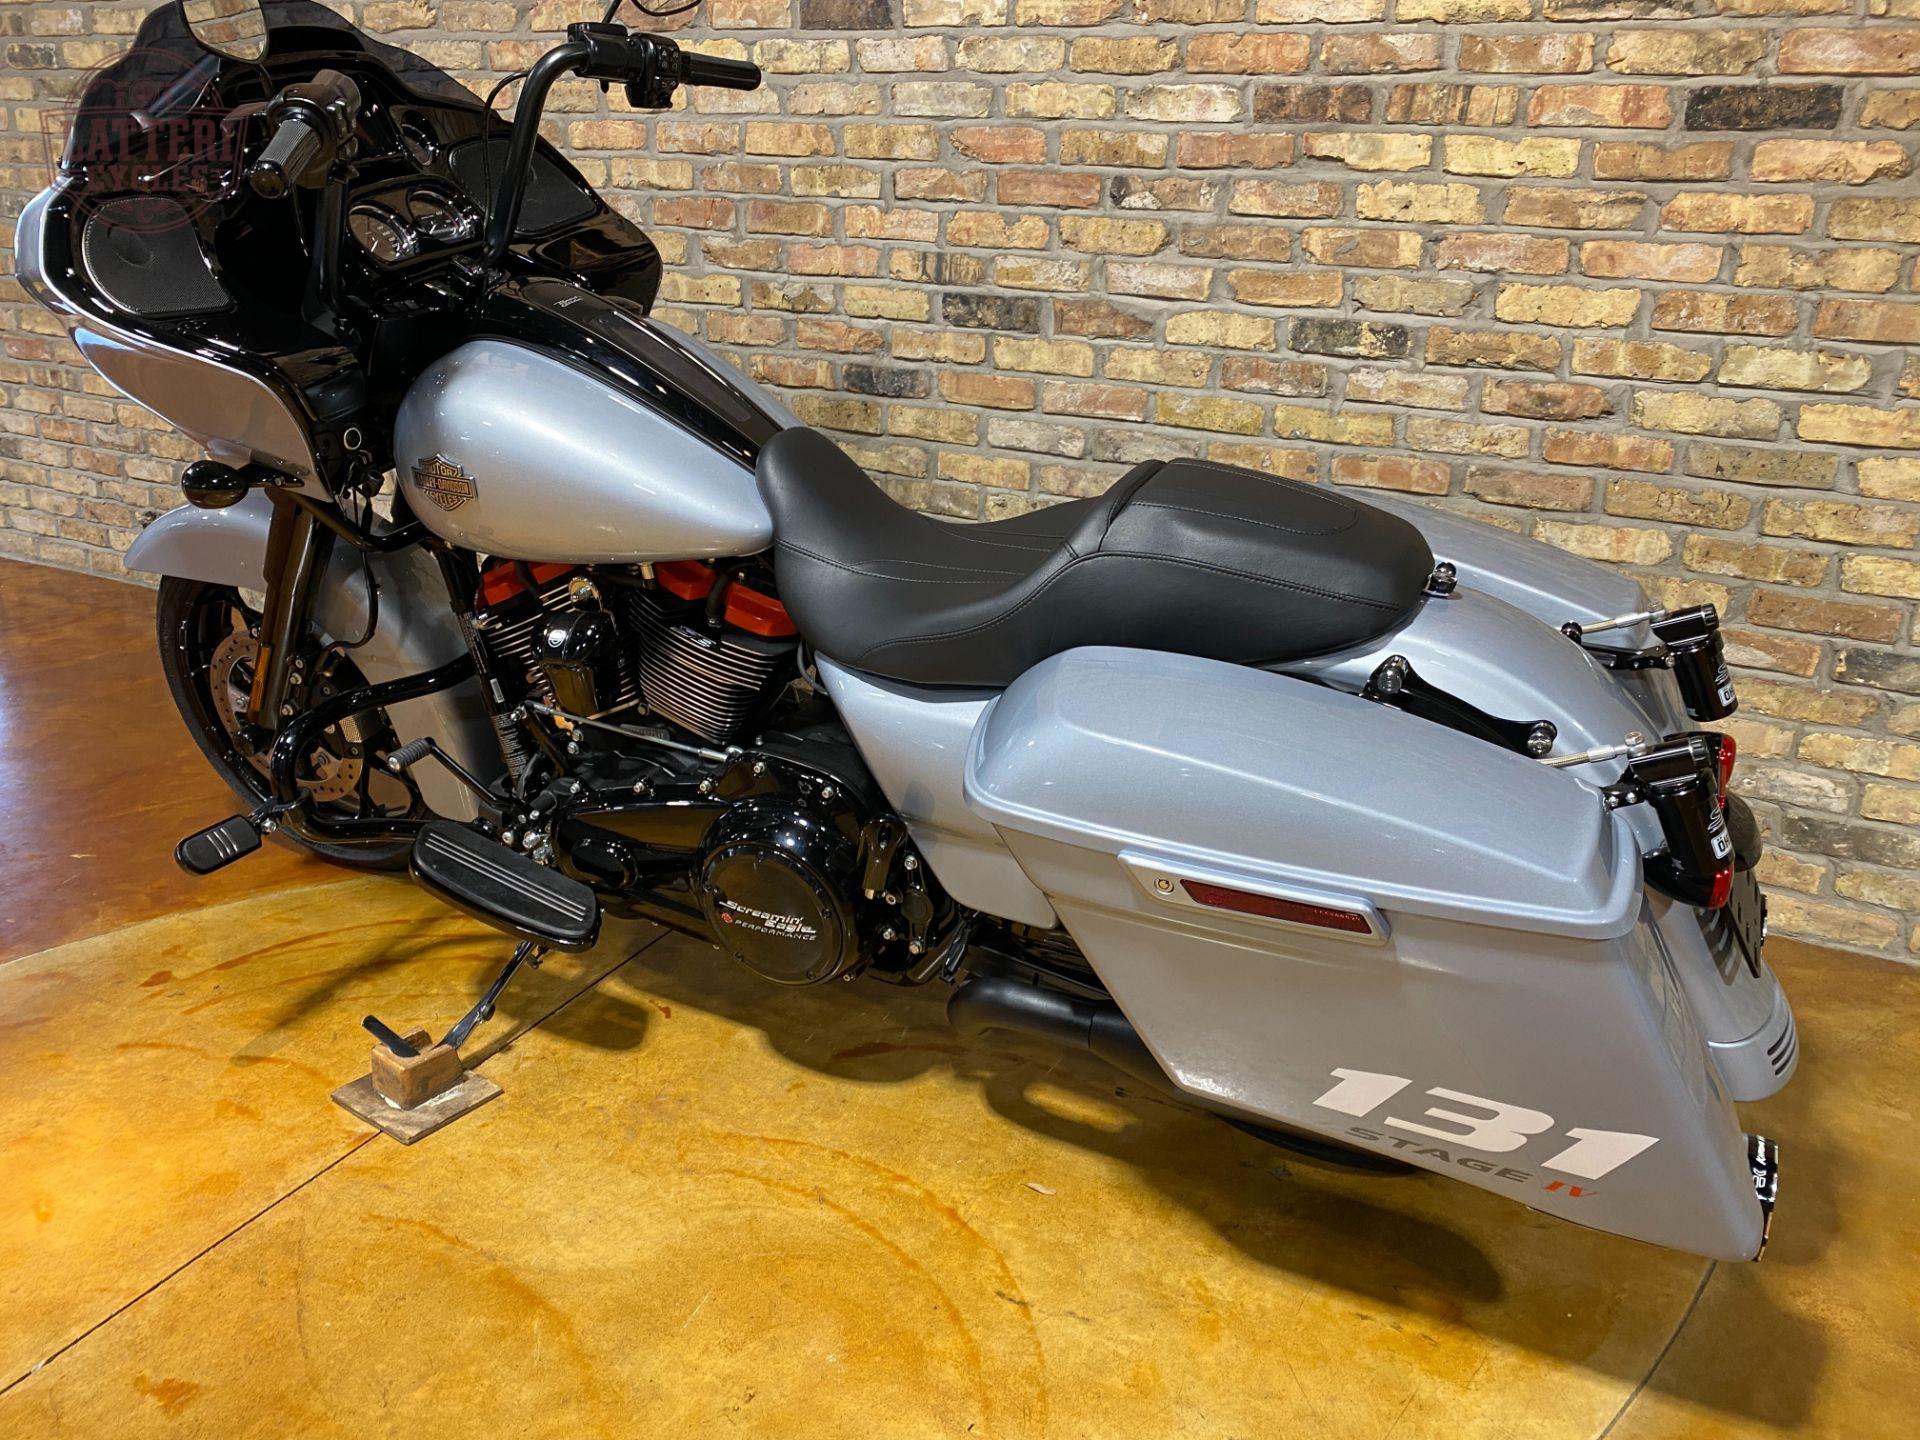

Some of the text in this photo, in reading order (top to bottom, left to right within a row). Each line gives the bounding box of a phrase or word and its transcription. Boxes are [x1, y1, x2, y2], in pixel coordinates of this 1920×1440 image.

[719, 900, 804, 925] Screamin'
[734, 919, 817, 941] PERFORMANCE
[764, 919, 816, 934] Eagle
[1311, 1067, 1661, 1180] 131
[1344, 1126, 1600, 1198] STAGE IV
